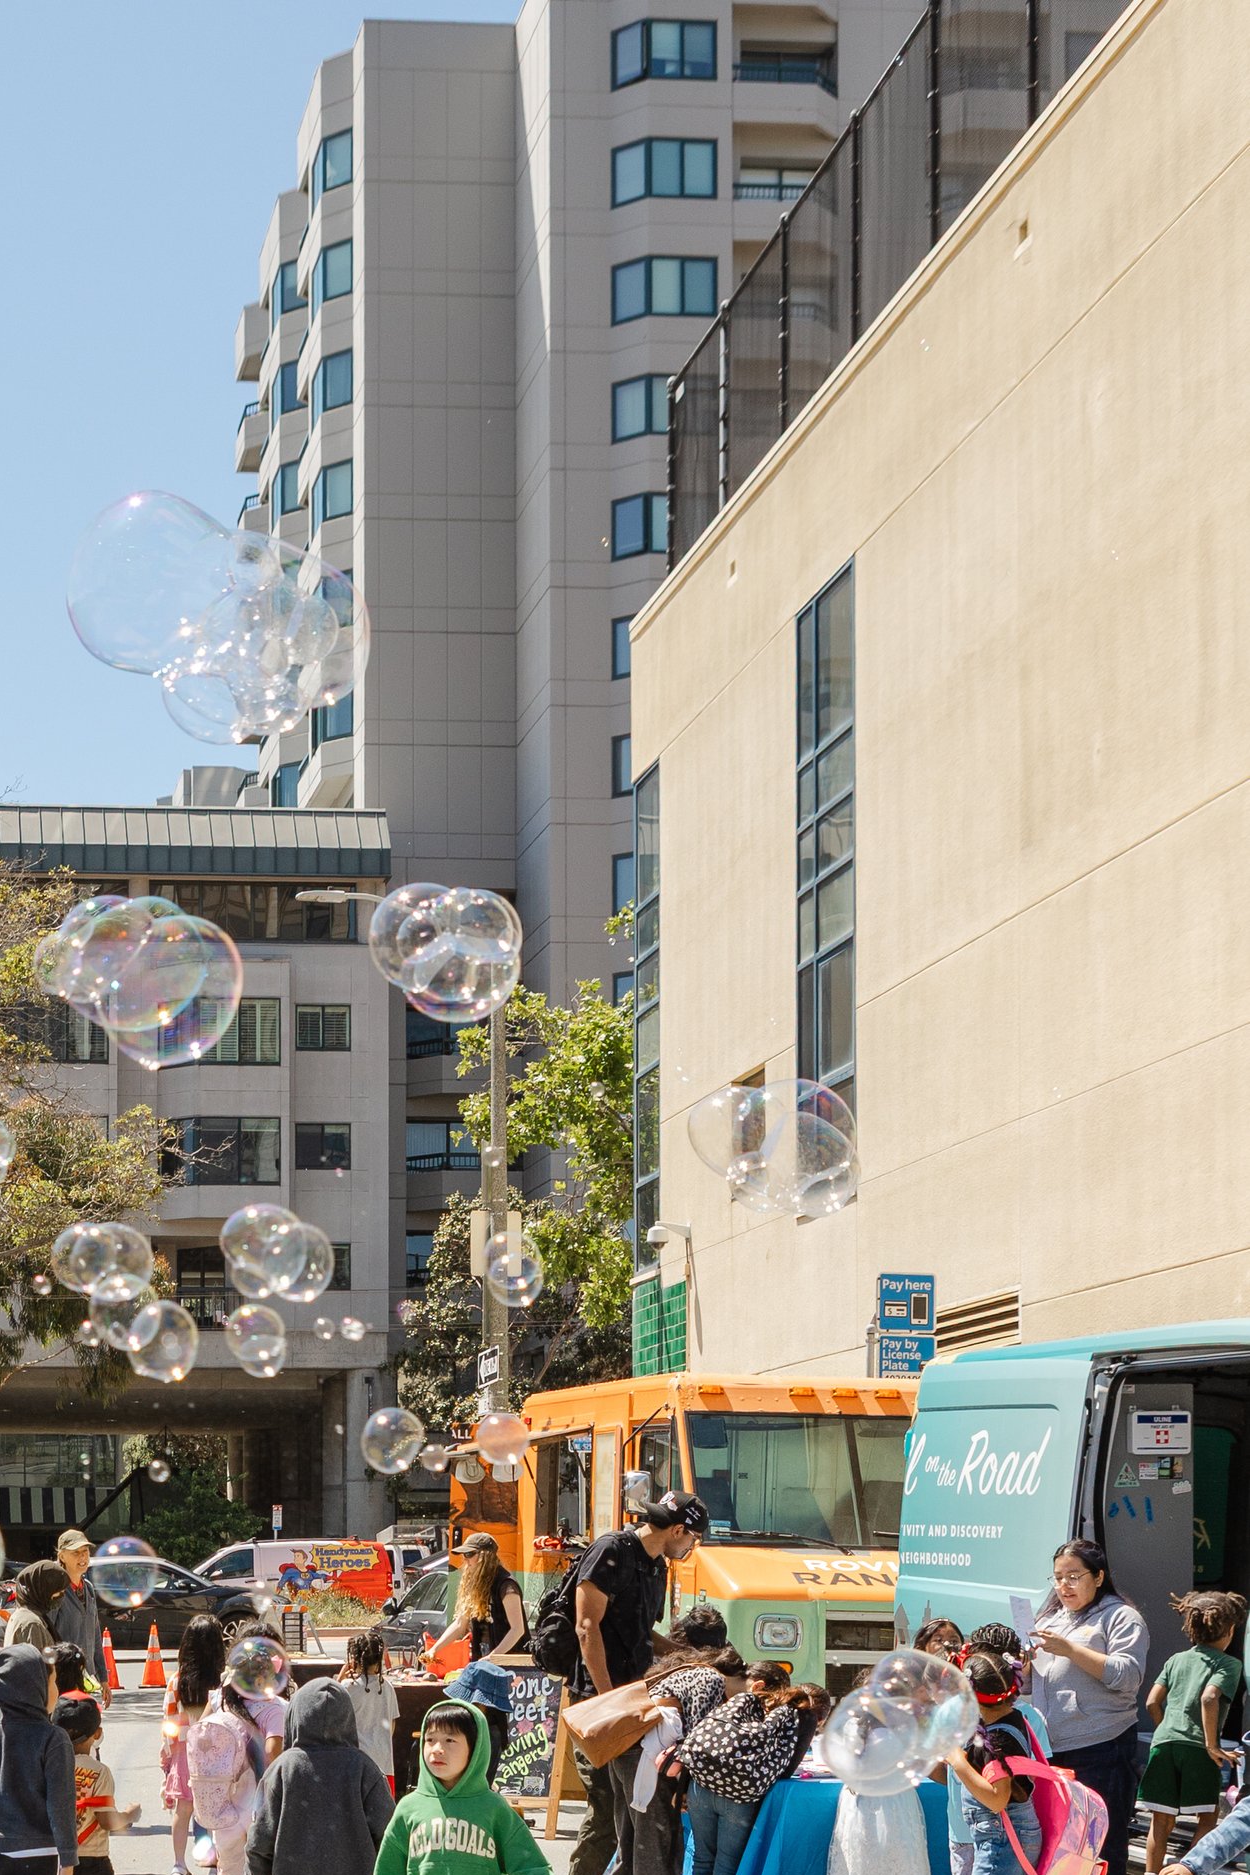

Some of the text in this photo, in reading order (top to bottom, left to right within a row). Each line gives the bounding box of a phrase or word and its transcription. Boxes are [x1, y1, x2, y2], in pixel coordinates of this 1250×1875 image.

[882, 1279, 931, 1293] Pay here
[882, 1339, 919, 1351] Pay by
[882, 1349, 921, 1360] License
[882, 1360, 909, 1371] Plate
[925, 1456, 940, 1472] on
[937, 1460, 956, 1487] the
[957, 1426, 1052, 1496] Road
[928, 1524, 947, 1537] AND
[950, 1524, 1003, 1539] DISCOVERY
[319, 1557, 371, 1568] Heroes
[791, 1572, 898, 1587] RAN
[509, 1696, 549, 1722] eet
[445, 1817, 496, 1859] GOALS
